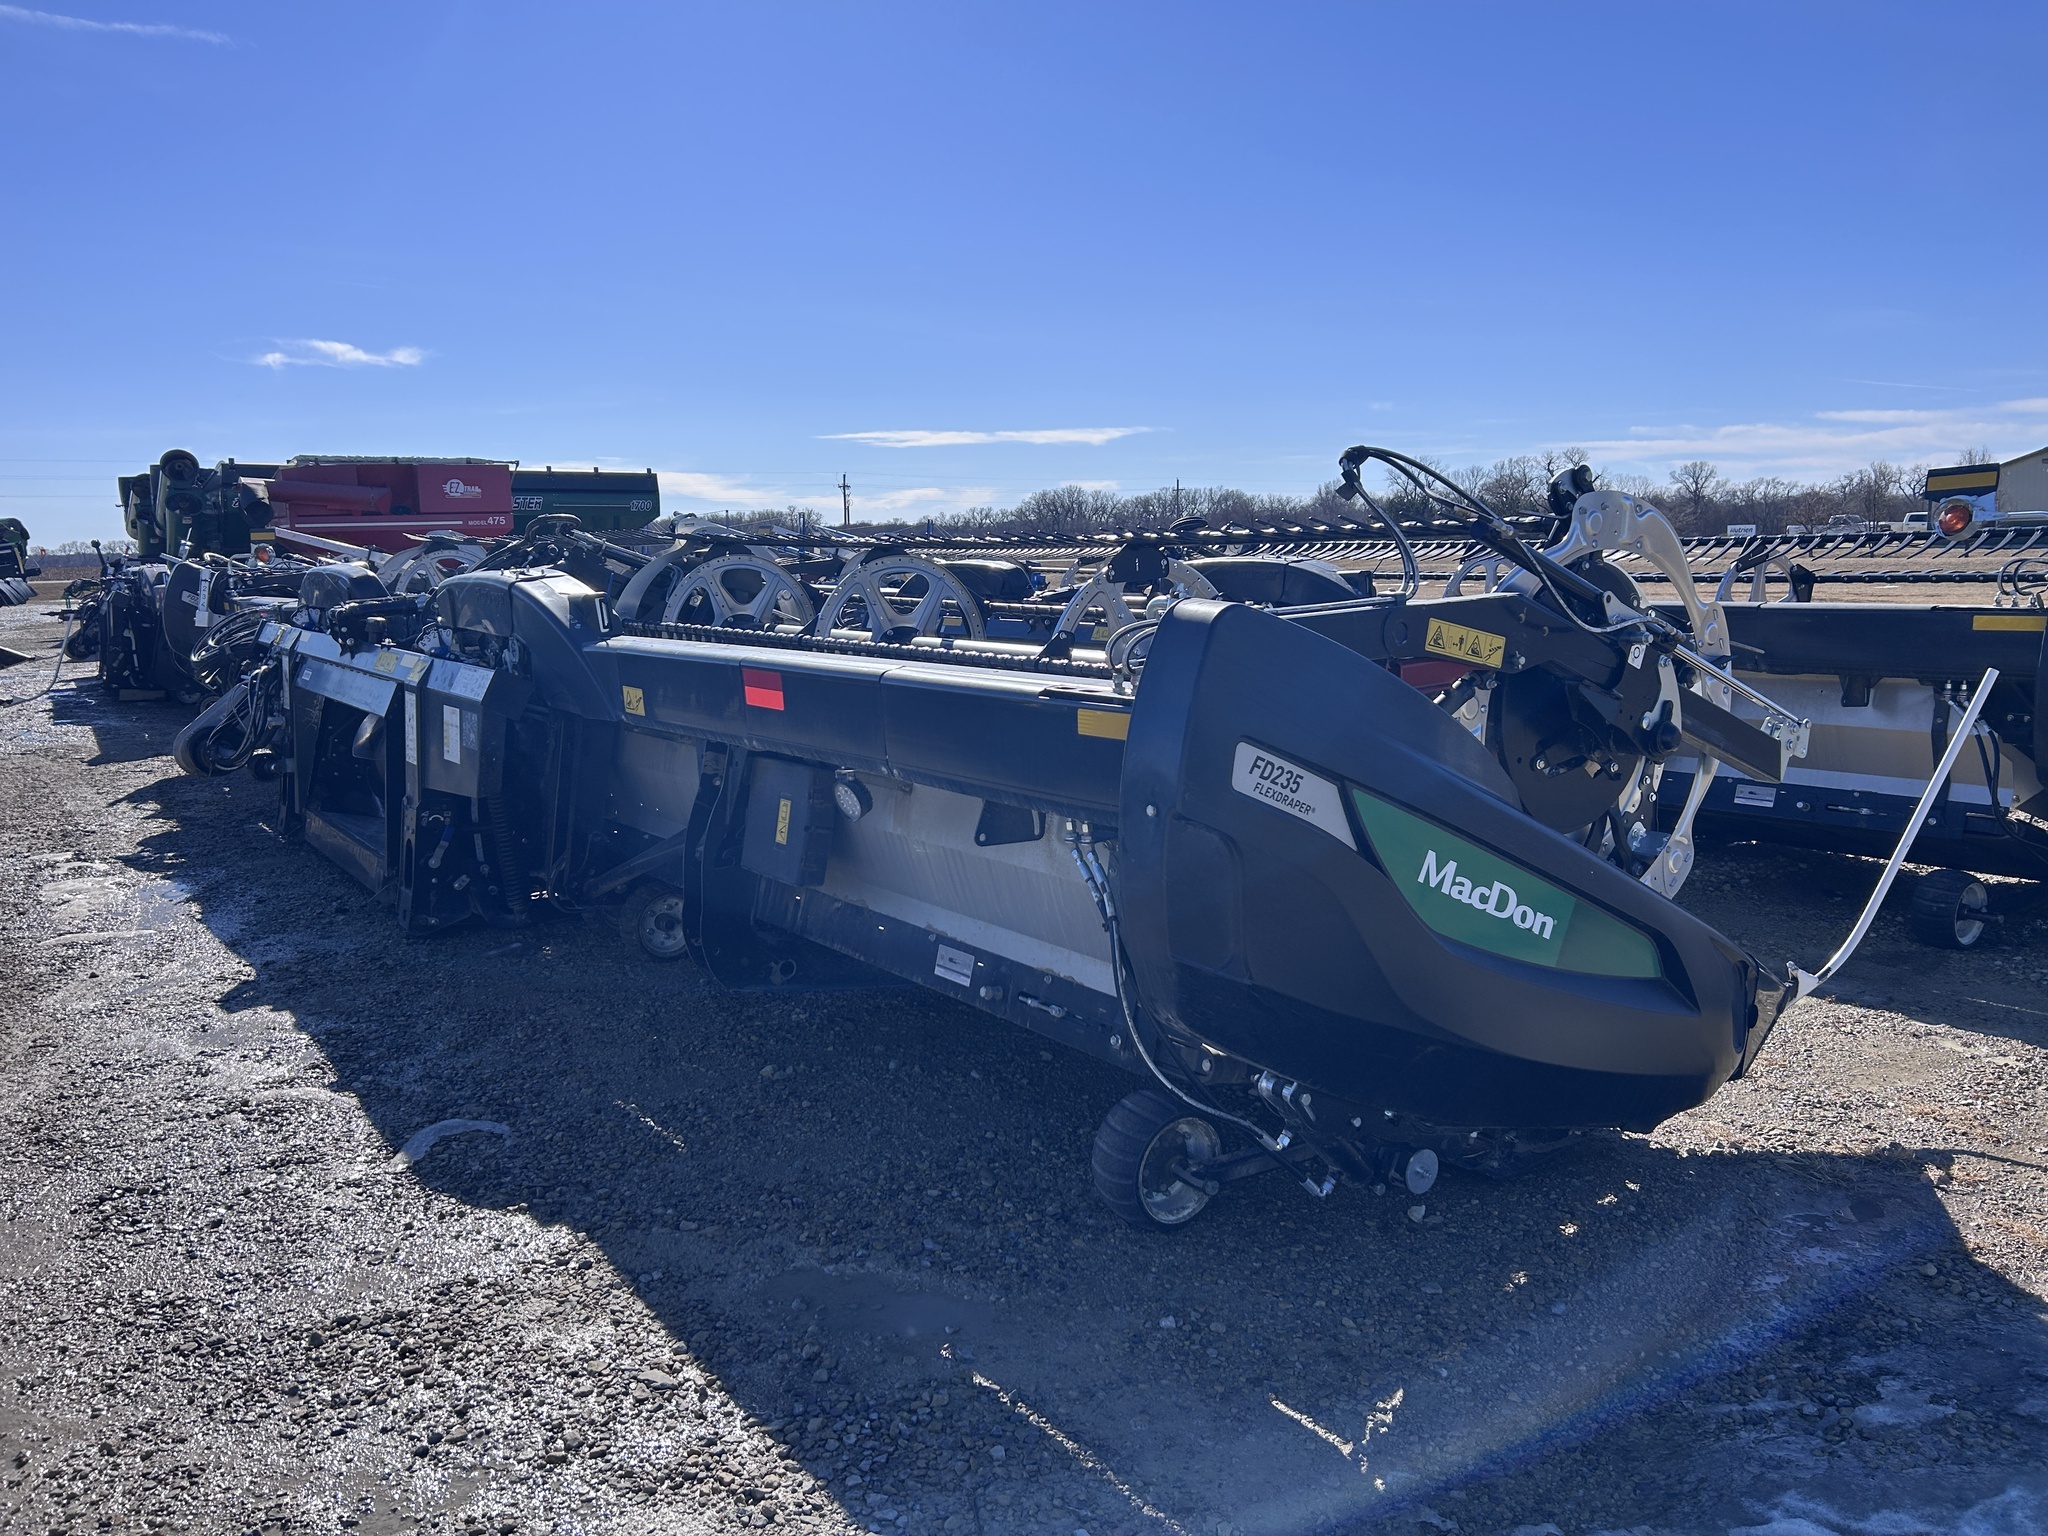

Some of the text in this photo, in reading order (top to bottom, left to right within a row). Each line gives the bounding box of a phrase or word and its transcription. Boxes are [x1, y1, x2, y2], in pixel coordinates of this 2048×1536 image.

[511, 495, 544, 511] STER
[630, 499, 653, 512] 1700
[487, 516, 506, 525] 475
[1248, 755, 1304, 794] FD235
[1417, 849, 1554, 940] MacDon
